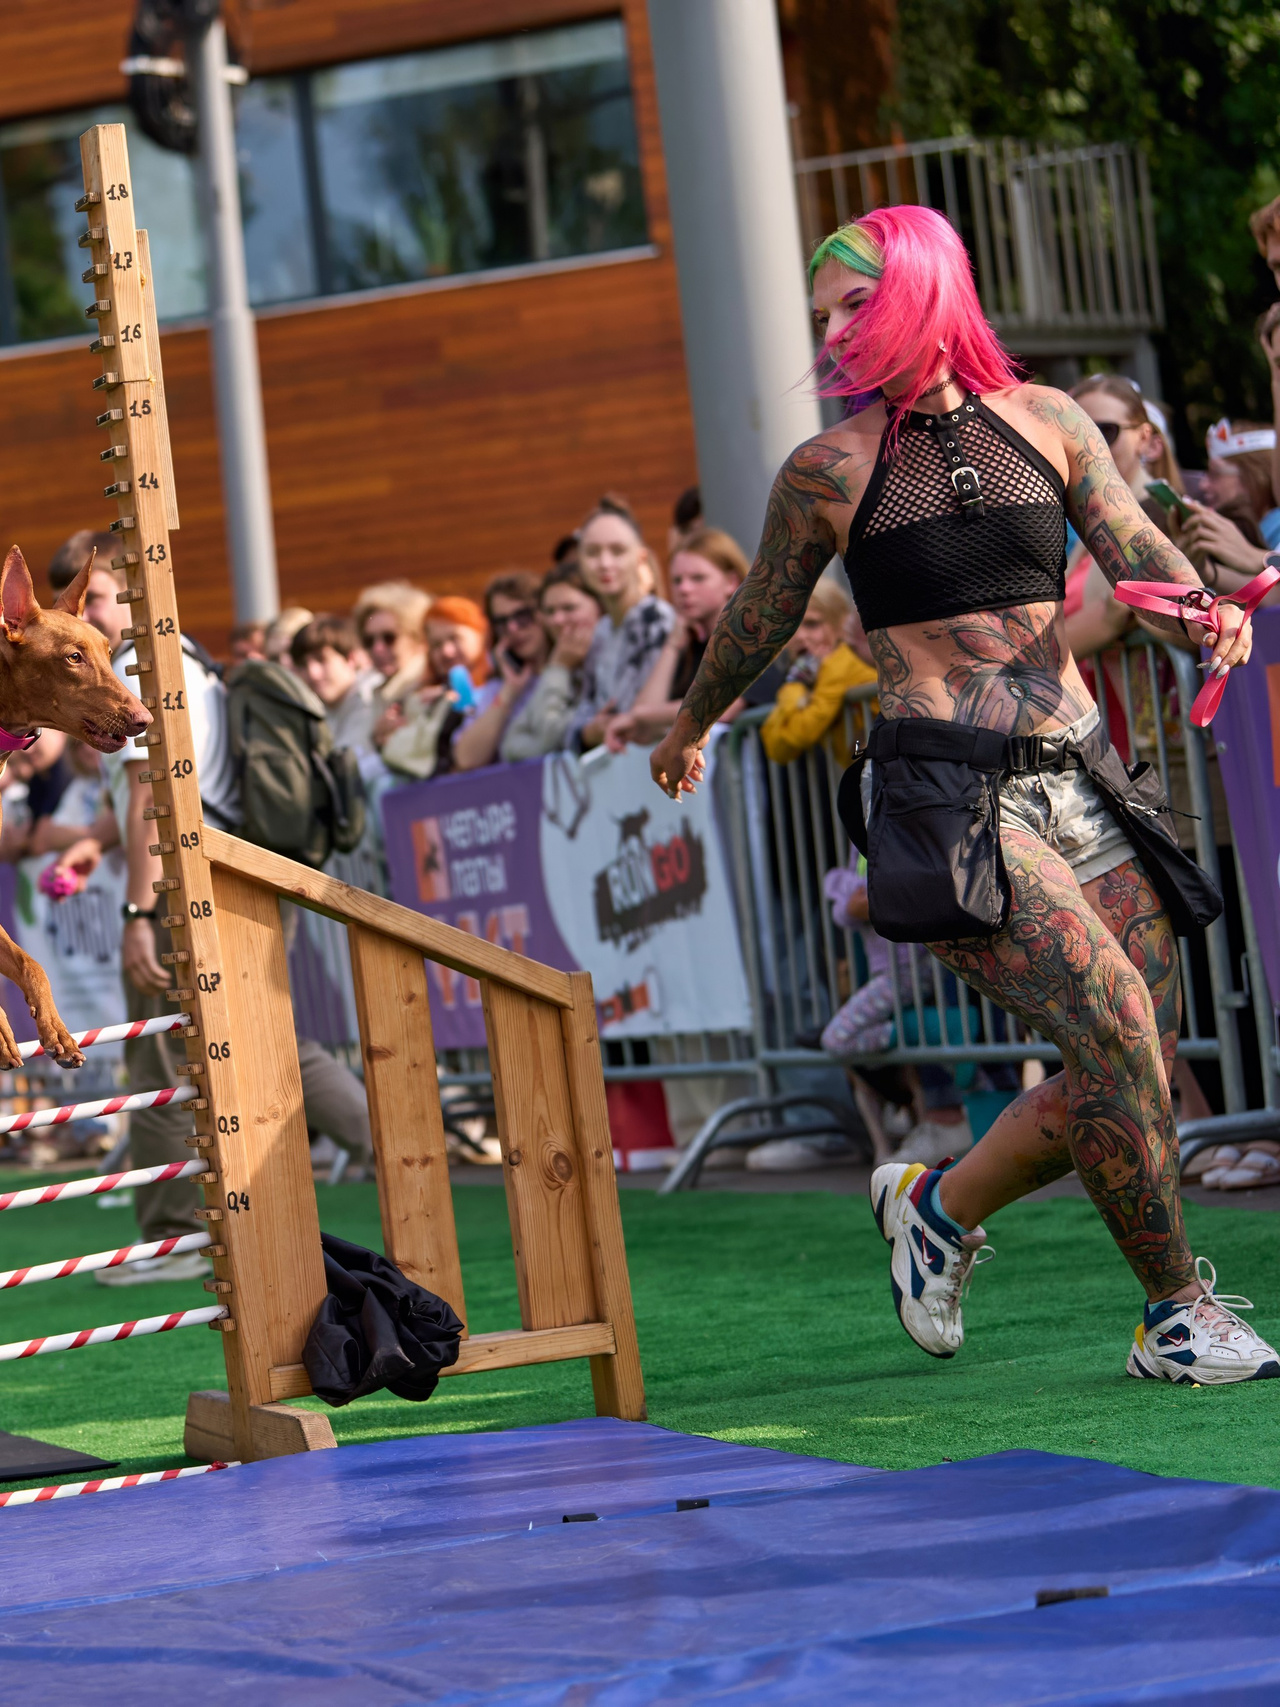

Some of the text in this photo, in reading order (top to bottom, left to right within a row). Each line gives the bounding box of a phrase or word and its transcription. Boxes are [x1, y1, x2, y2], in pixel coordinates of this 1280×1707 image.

[106, 183, 129, 201] 1,8
[120, 323, 142, 344] 1,6
[129, 399, 152, 419] 1,5
[138, 472, 160, 490] 1,4
[145, 543, 167, 565] 1,3
[155, 617, 176, 636] 1,2
[162, 690, 185, 711] 1,1
[171, 759, 194, 779] 1,0
[180, 831, 200, 850] 0,9
[190, 900, 212, 920] 0,8
[208, 1041, 231, 1061] 0,6
[217, 1115, 240, 1136] 0,5
[227, 1191, 250, 1214] 0,4
